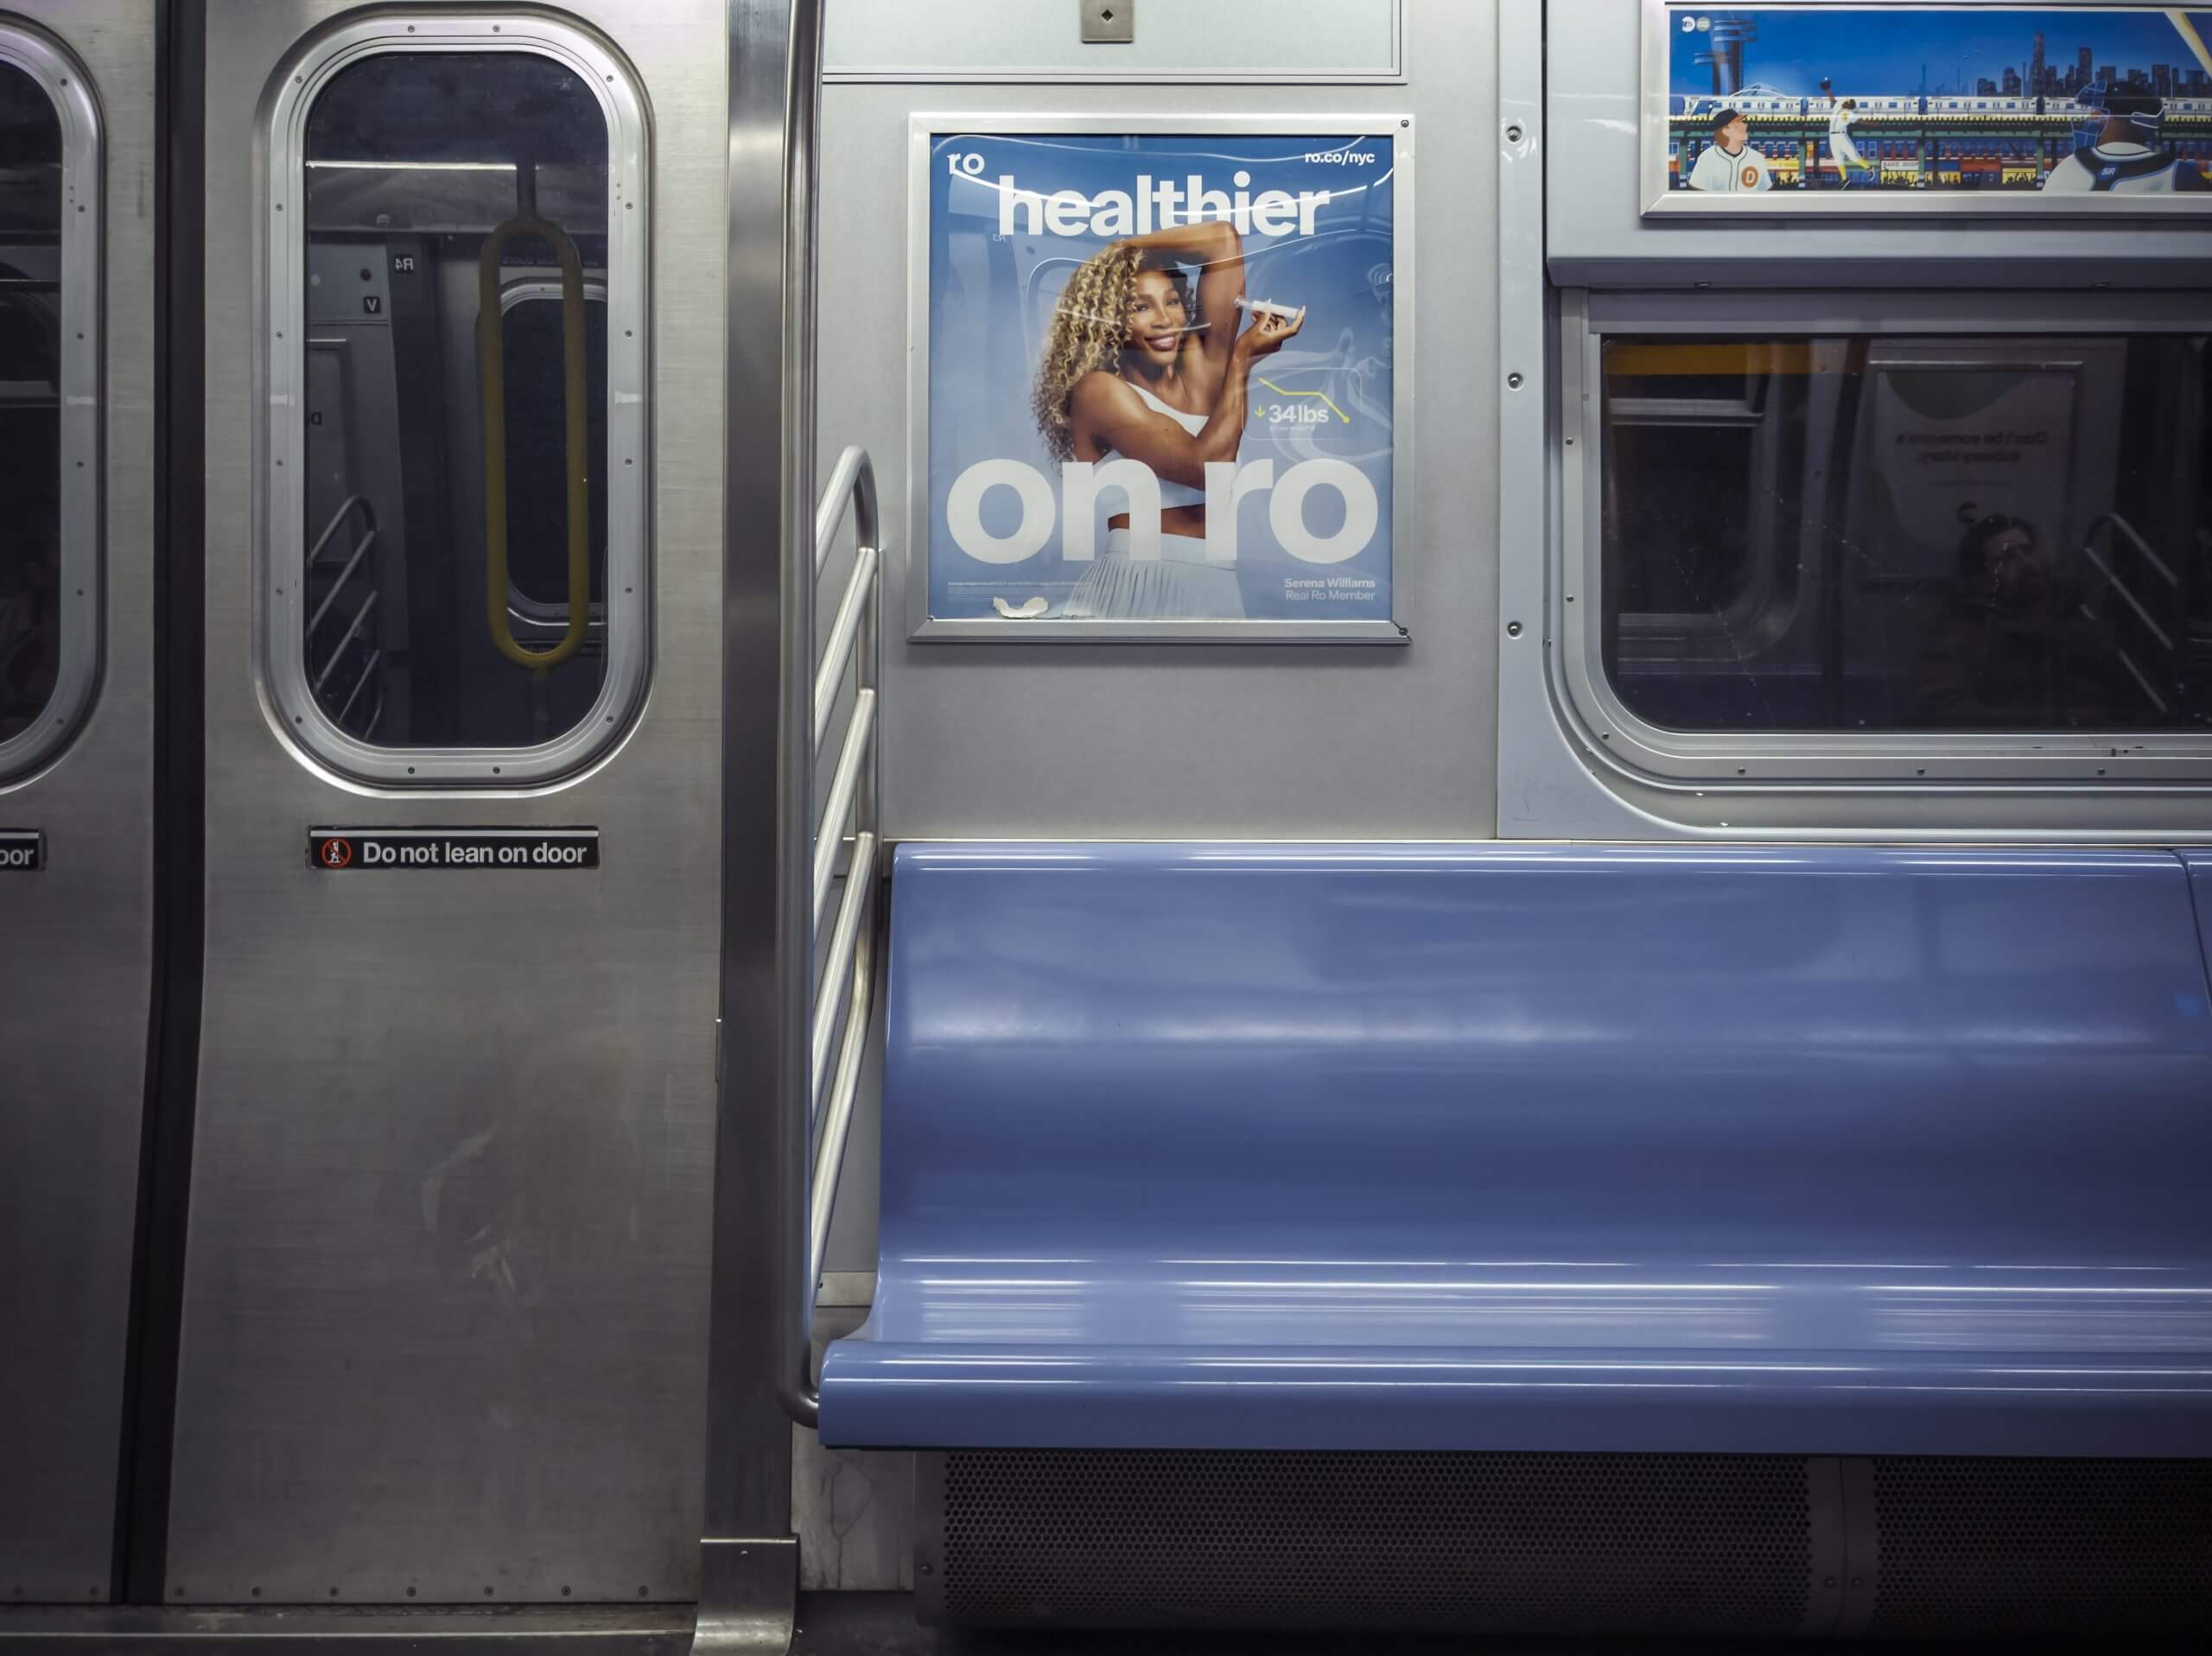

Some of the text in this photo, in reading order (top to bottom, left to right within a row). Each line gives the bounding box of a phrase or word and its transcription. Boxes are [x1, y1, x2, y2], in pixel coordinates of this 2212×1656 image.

[947, 153, 985, 175] ro
[1305, 150, 1376, 166] ro.co/nyc
[1745, 170, 1756, 183] D
[999, 171, 1330, 237] healthier
[947, 459, 1377, 563] on ro
[1285, 577, 1376, 588] Serena Williams
[1286, 590, 1376, 601] Real Ro Member
[364, 842, 588, 863] Do not lean on door
